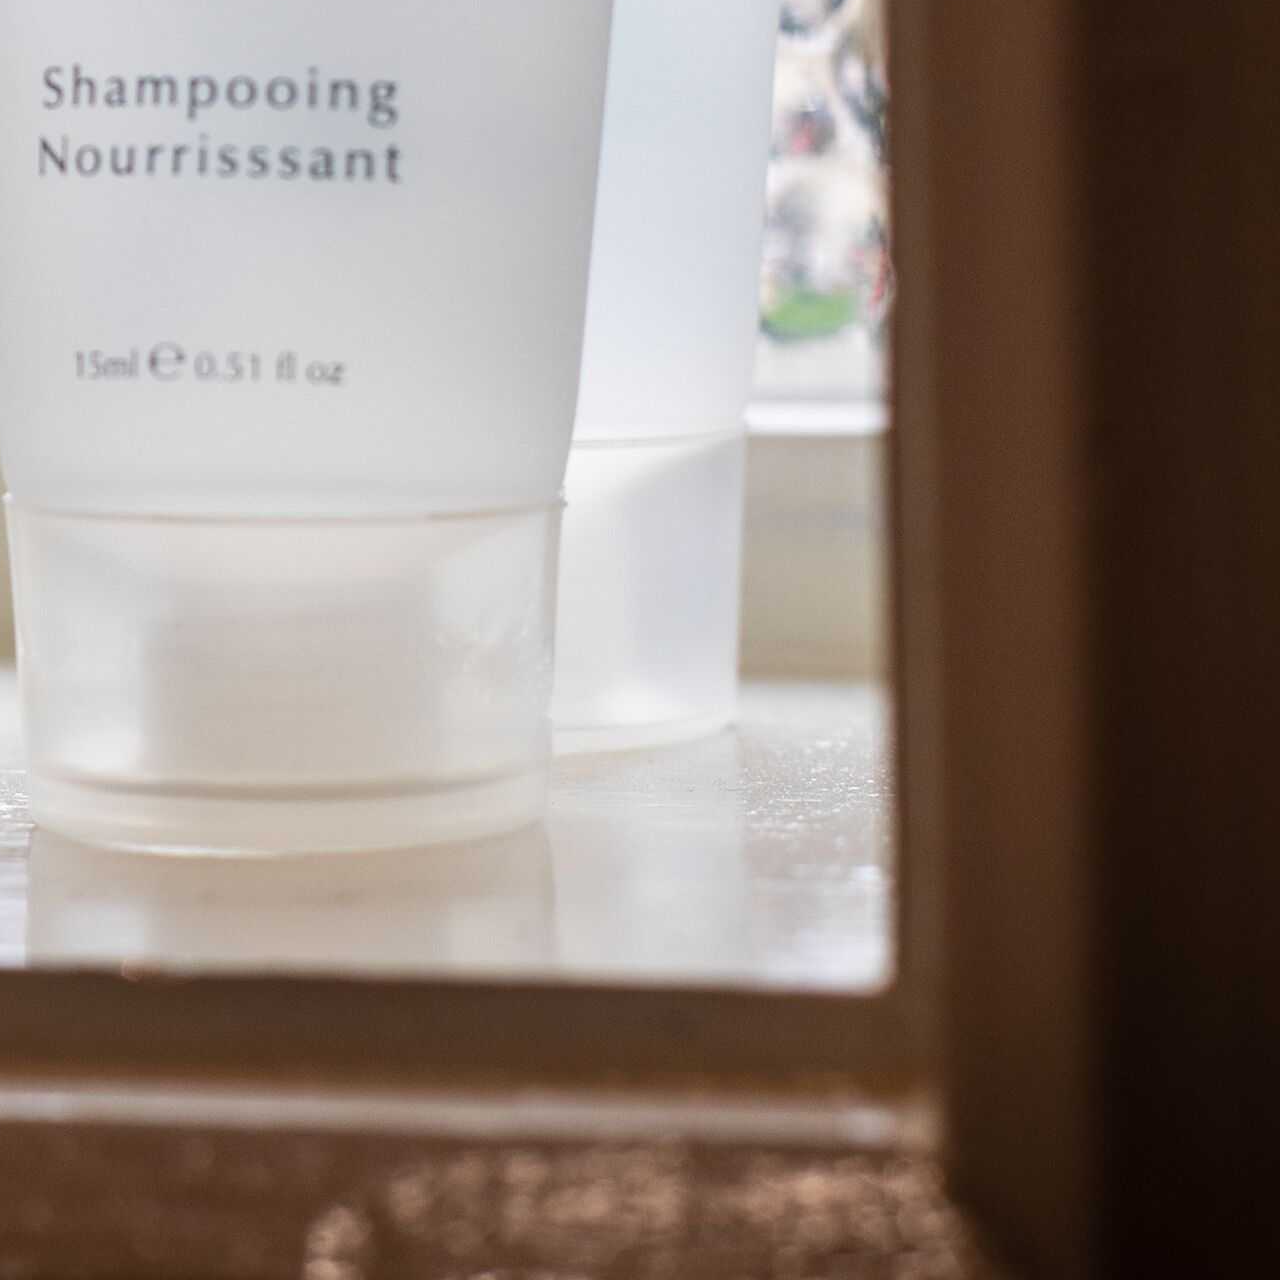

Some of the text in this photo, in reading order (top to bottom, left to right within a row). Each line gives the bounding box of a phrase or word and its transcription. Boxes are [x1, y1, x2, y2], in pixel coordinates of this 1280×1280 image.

[41, 65, 400, 128] Shampooing
[38, 135, 403, 184] Nourrisssant
[75, 349, 140, 381] 15ml
[193, 350, 262, 383] 0.51
[305, 361, 346, 386] oz
